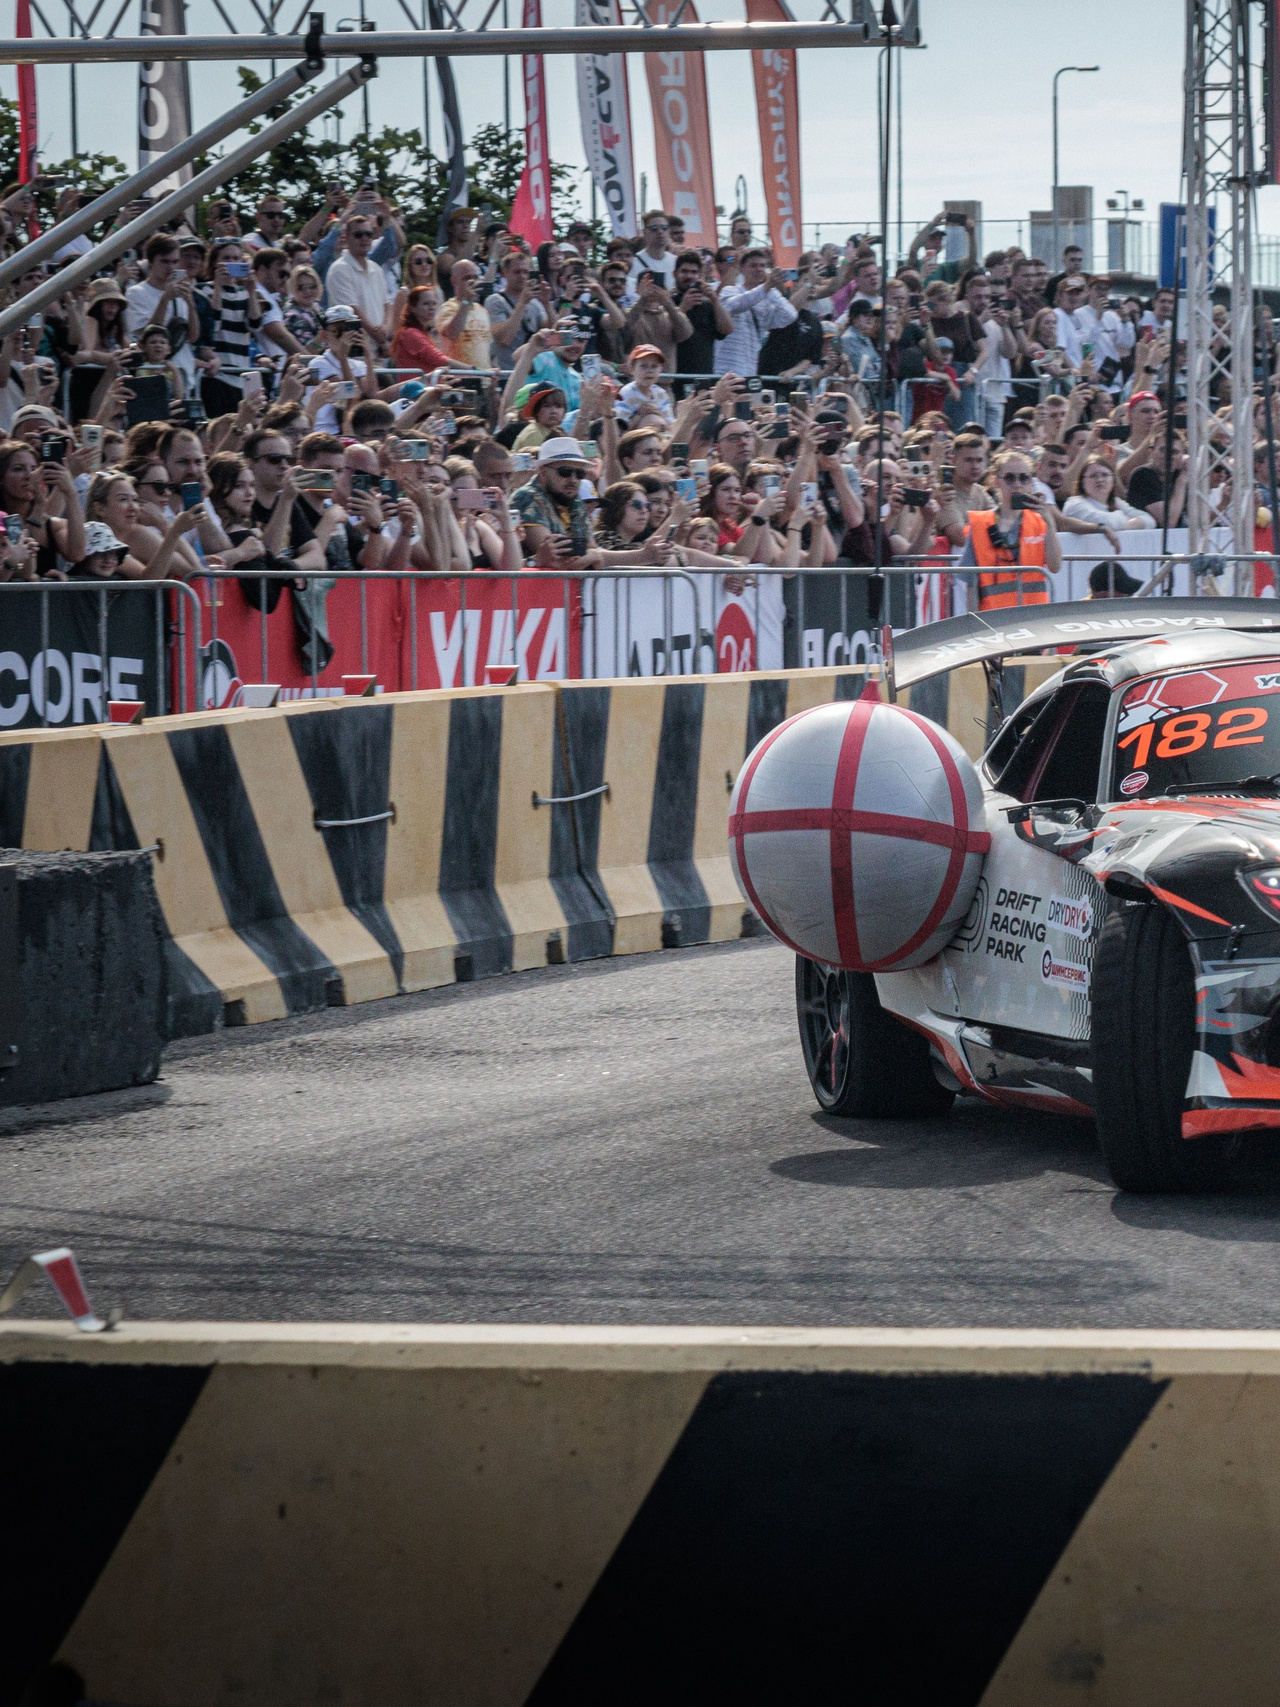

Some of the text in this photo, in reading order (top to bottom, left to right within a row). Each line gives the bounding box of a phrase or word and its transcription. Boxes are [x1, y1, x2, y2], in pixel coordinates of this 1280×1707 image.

[920, 616, 1226, 659] RACING PARK
[1118, 707, 1268, 768] 182
[995, 888, 1042, 915] DRIFT
[989, 912, 1047, 943] RACING
[986, 937, 1026, 964] PARK
